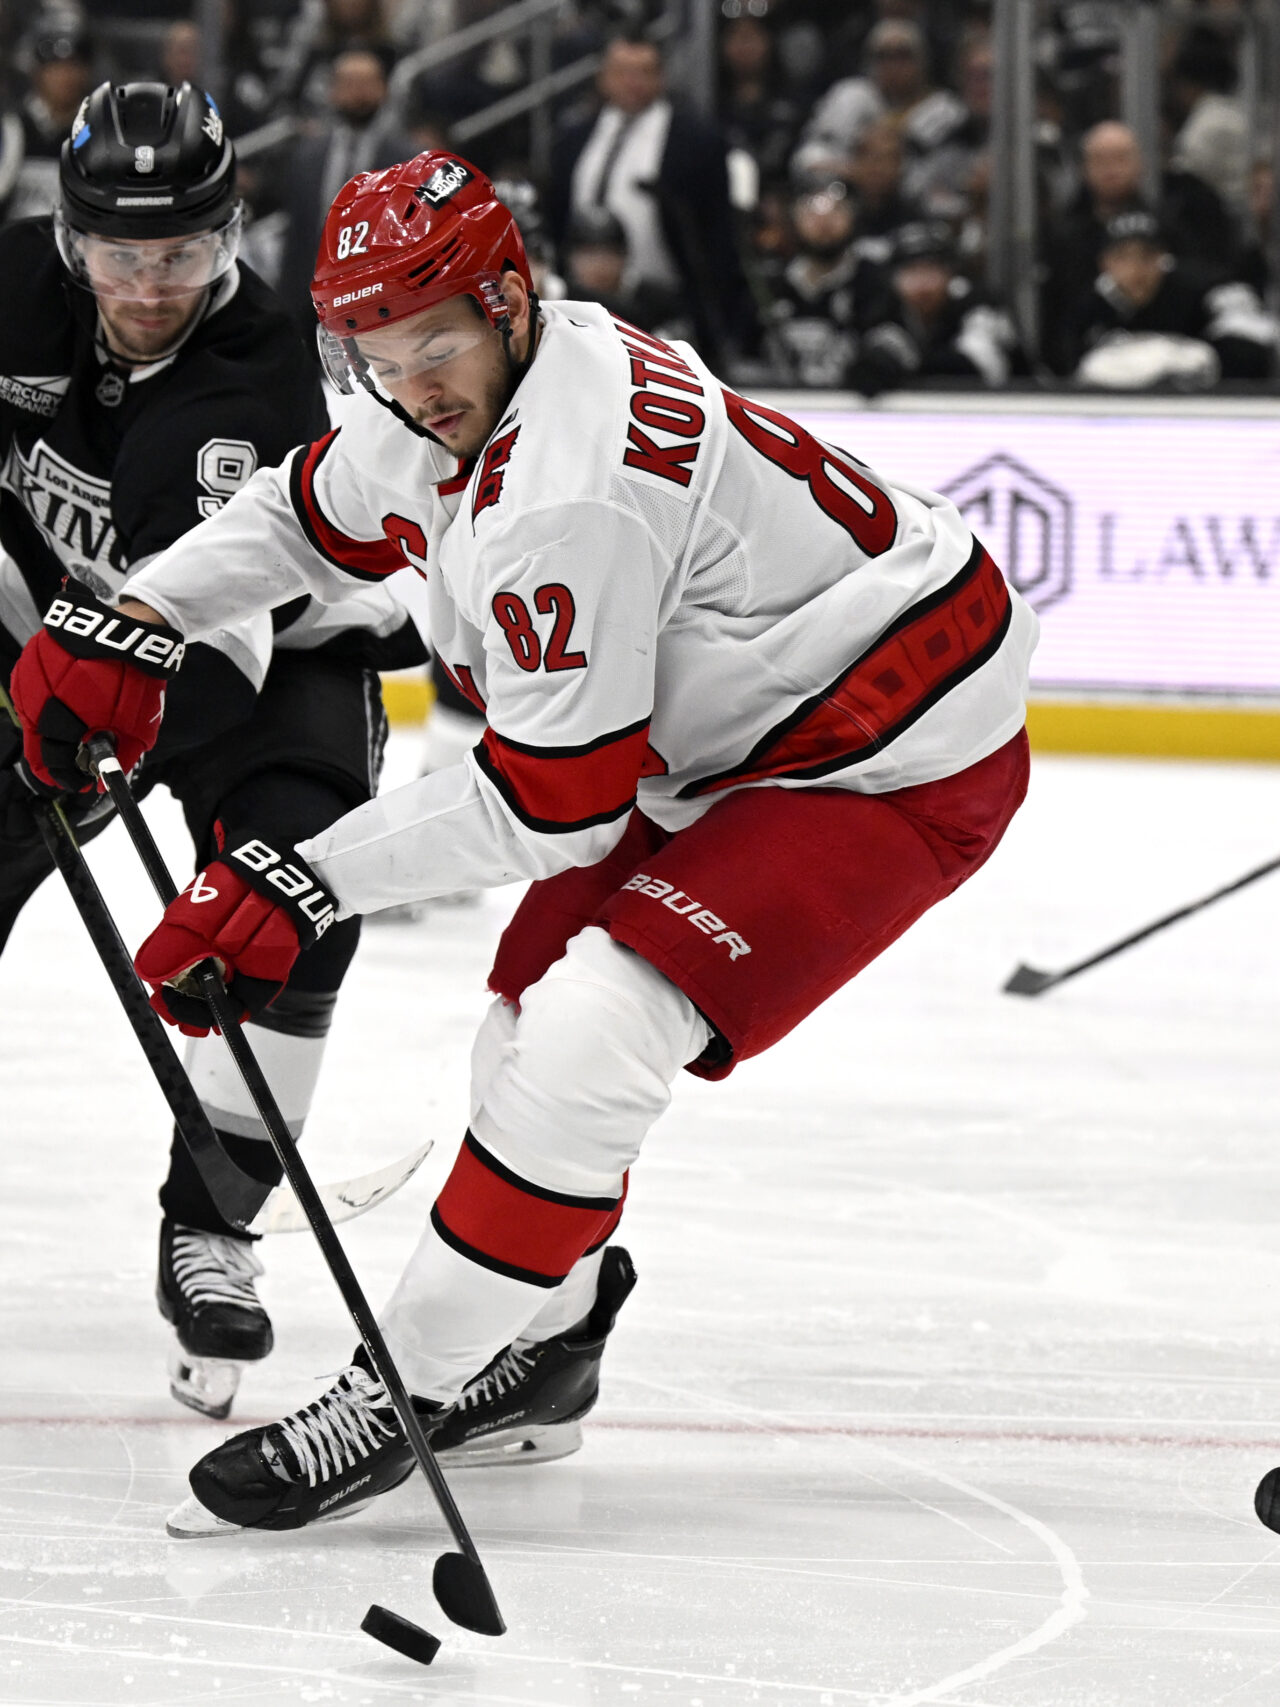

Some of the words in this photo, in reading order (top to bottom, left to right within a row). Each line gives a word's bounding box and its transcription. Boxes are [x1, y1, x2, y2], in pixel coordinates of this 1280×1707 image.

[135, 145, 155, 173] 9
[422, 163, 468, 203] Lenovo
[336, 221, 370, 260] 82
[609, 311, 706, 489] KOTKA
[44, 468, 70, 491] Los
[196, 438, 258, 520] 9
[492, 583, 588, 673] 82
